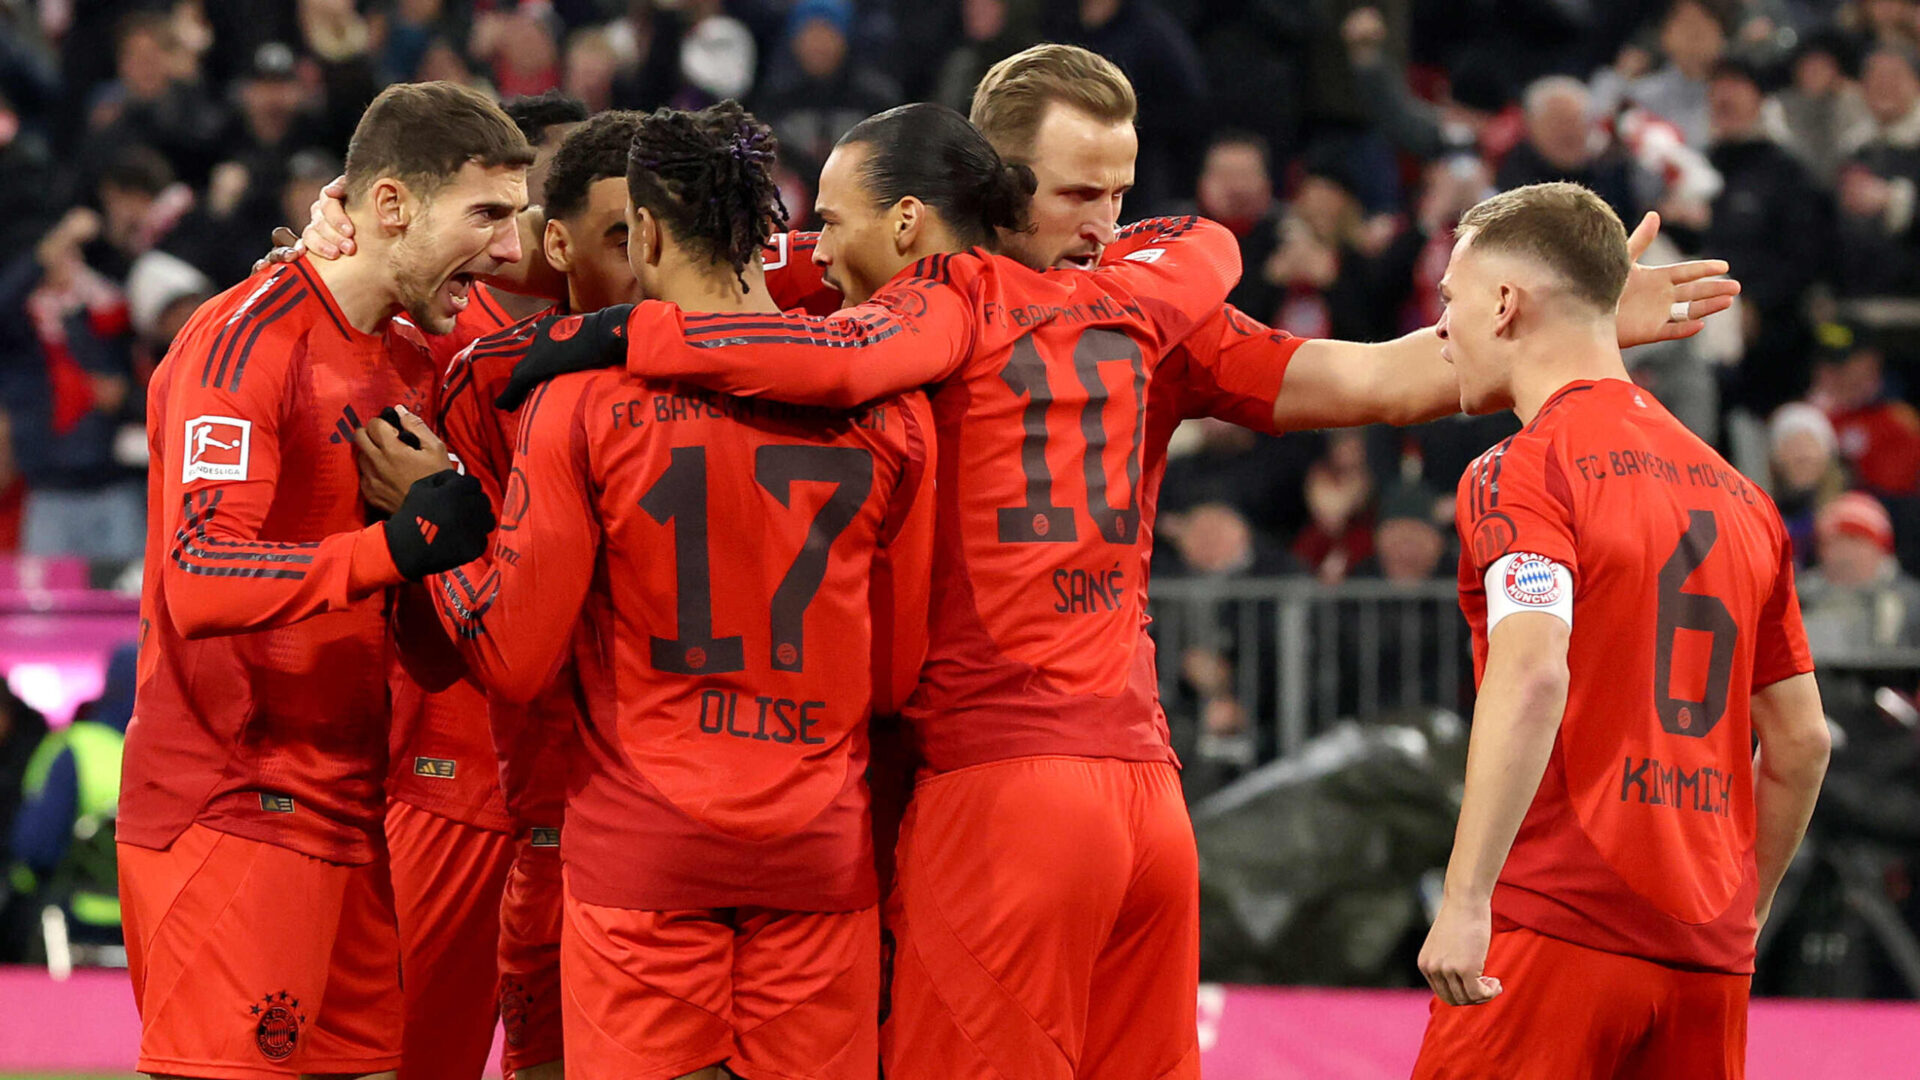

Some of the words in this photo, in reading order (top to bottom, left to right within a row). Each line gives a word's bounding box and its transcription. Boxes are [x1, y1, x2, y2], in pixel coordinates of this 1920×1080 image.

[612, 400, 644, 428] FC
[997, 328, 1146, 545] 10
[188, 465, 240, 477] NDESLIGA
[1576, 455, 1606, 481] FC
[1609, 450, 1681, 485] BAYERN
[637, 445, 874, 675] 17
[1053, 562, 1125, 613] SANÉ
[1654, 509, 1738, 738] 6
[700, 690, 826, 744] OLISE
